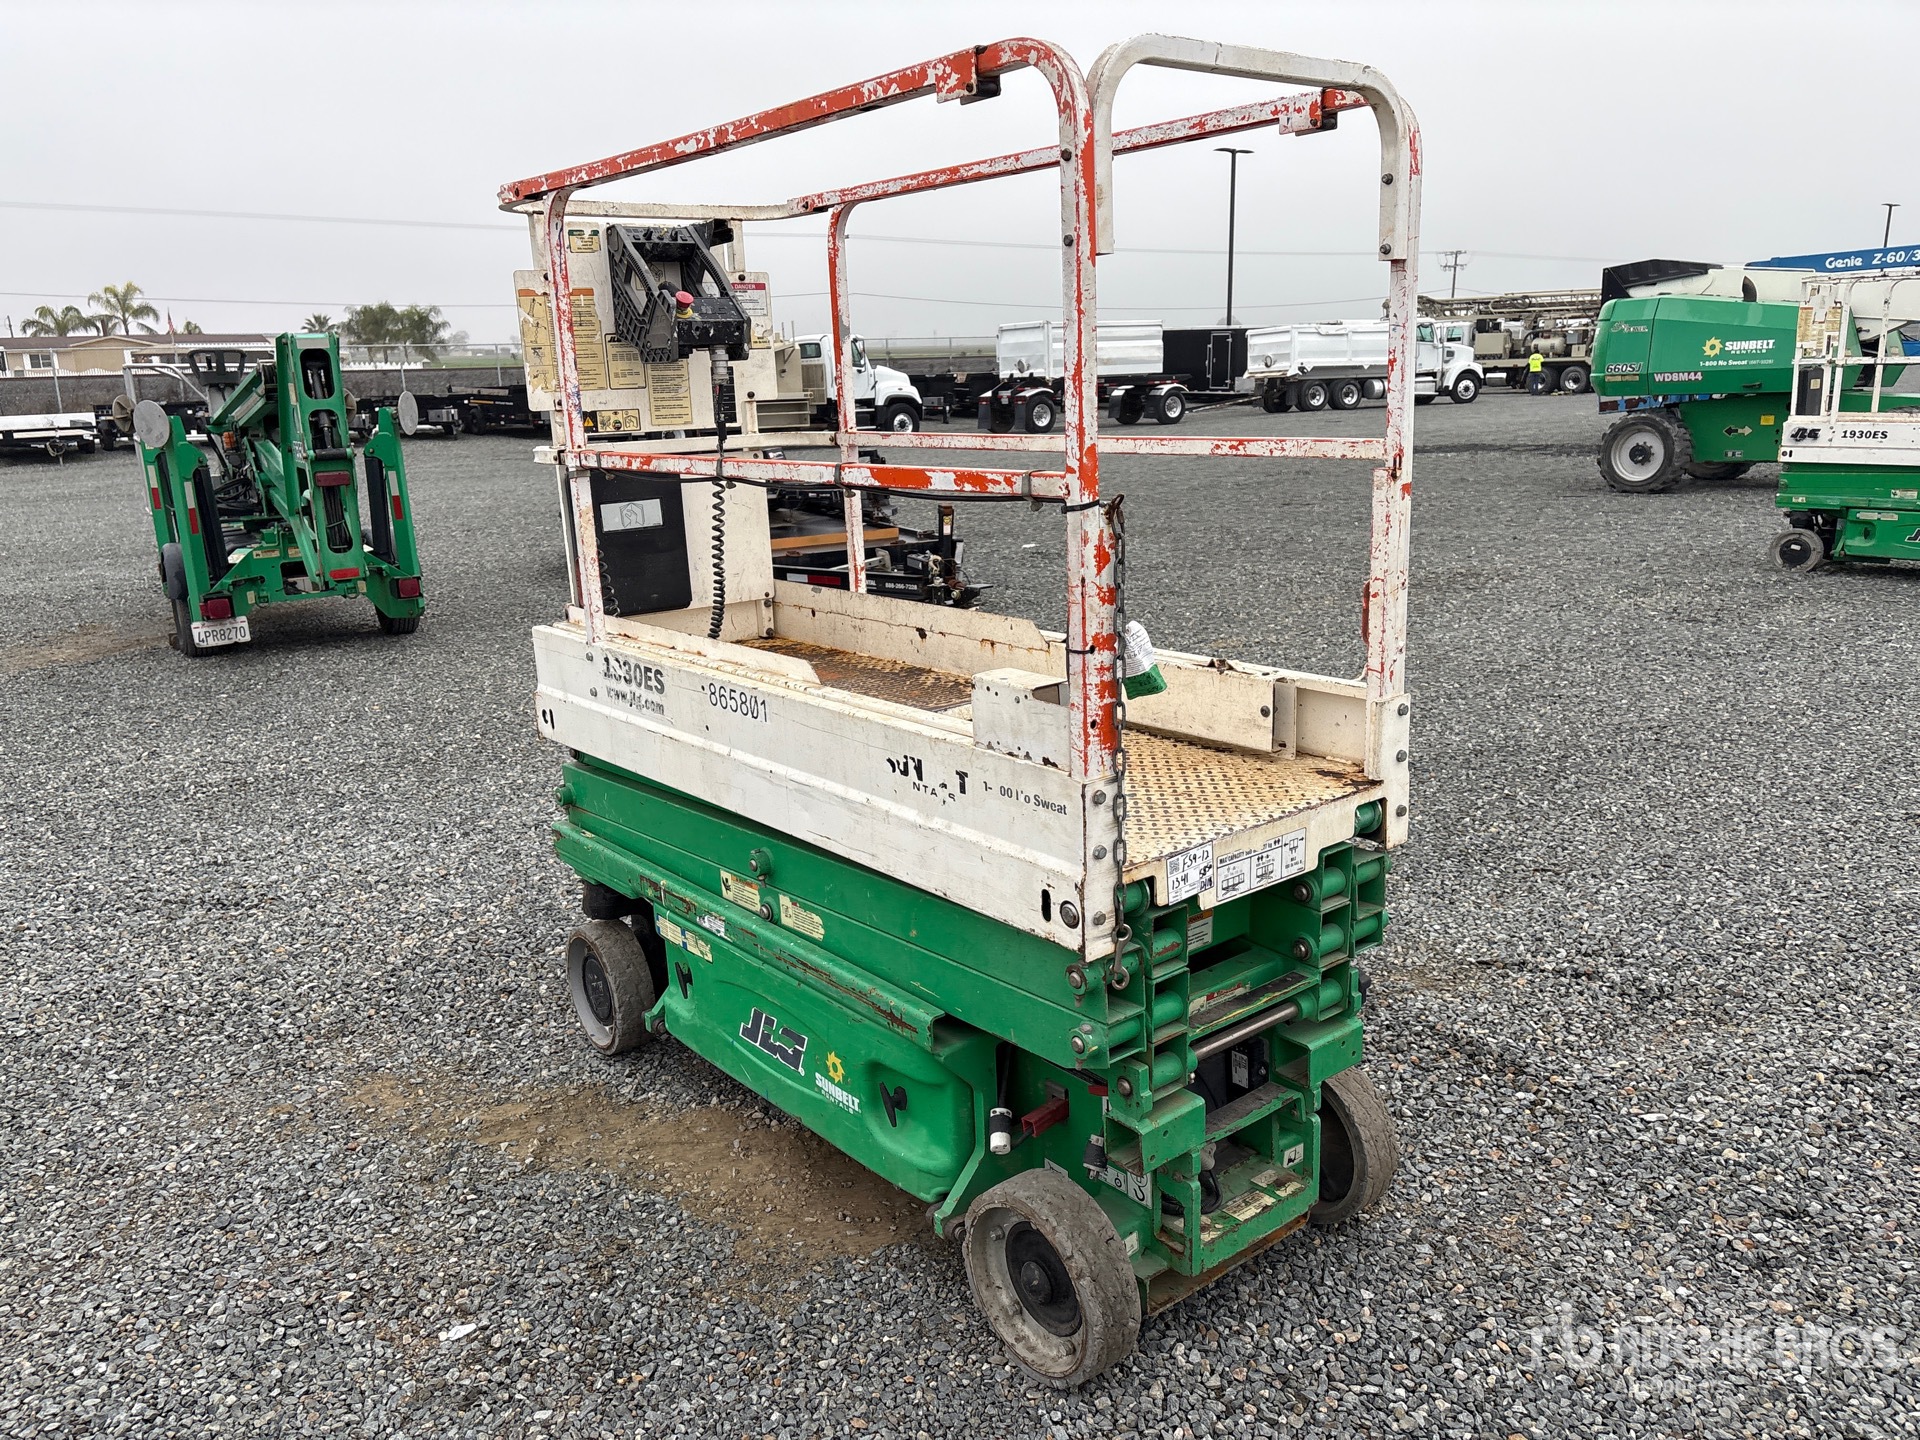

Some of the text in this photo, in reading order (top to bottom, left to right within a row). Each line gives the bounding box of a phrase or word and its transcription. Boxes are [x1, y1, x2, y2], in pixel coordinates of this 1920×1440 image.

[1825, 256, 1863, 268] Genie
[1724, 339, 1776, 351] SUNBELT
[1605, 362, 1643, 373] 660SJ
[1653, 371, 1703, 383] WD8M44
[1841, 430, 1889, 440] 1930ES
[197, 626, 246, 644] 4PR8270
[708, 682, 767, 723] 865801
[814, 1071, 860, 1112] SUNBELT
[820, 1089, 855, 1115] RENTALS
